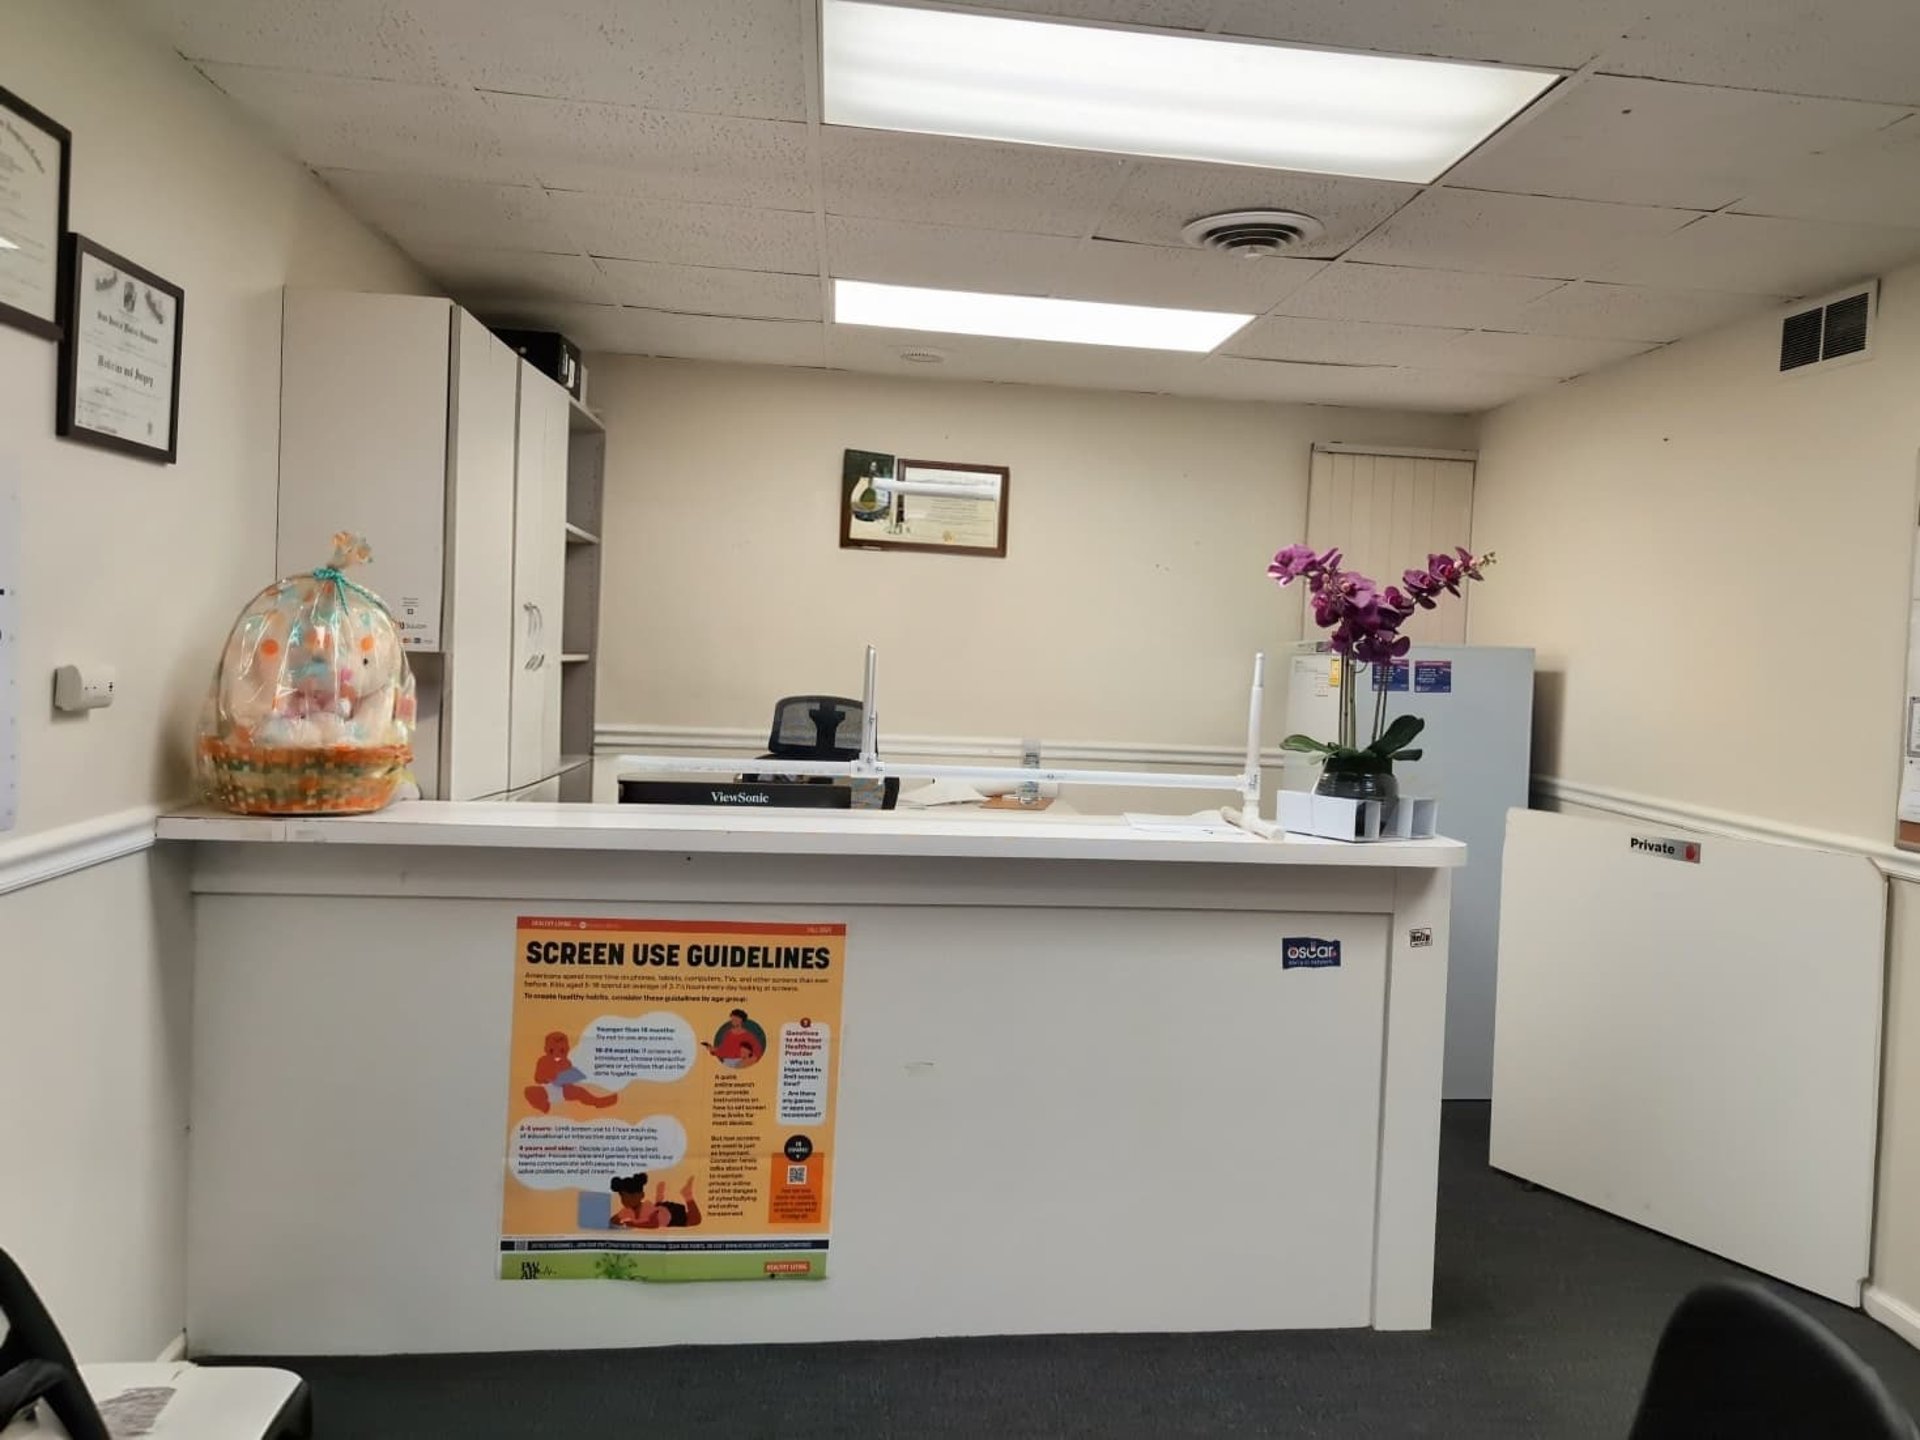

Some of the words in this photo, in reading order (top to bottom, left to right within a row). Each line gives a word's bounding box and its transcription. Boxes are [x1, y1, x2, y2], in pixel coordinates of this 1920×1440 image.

[711, 791, 769, 803] ViewSonic
[1630, 837, 1675, 854] Private
[526, 941, 624, 965] SCREEN
[632, 943, 680, 967] USE
[687, 944, 830, 969] GUIDELINES
